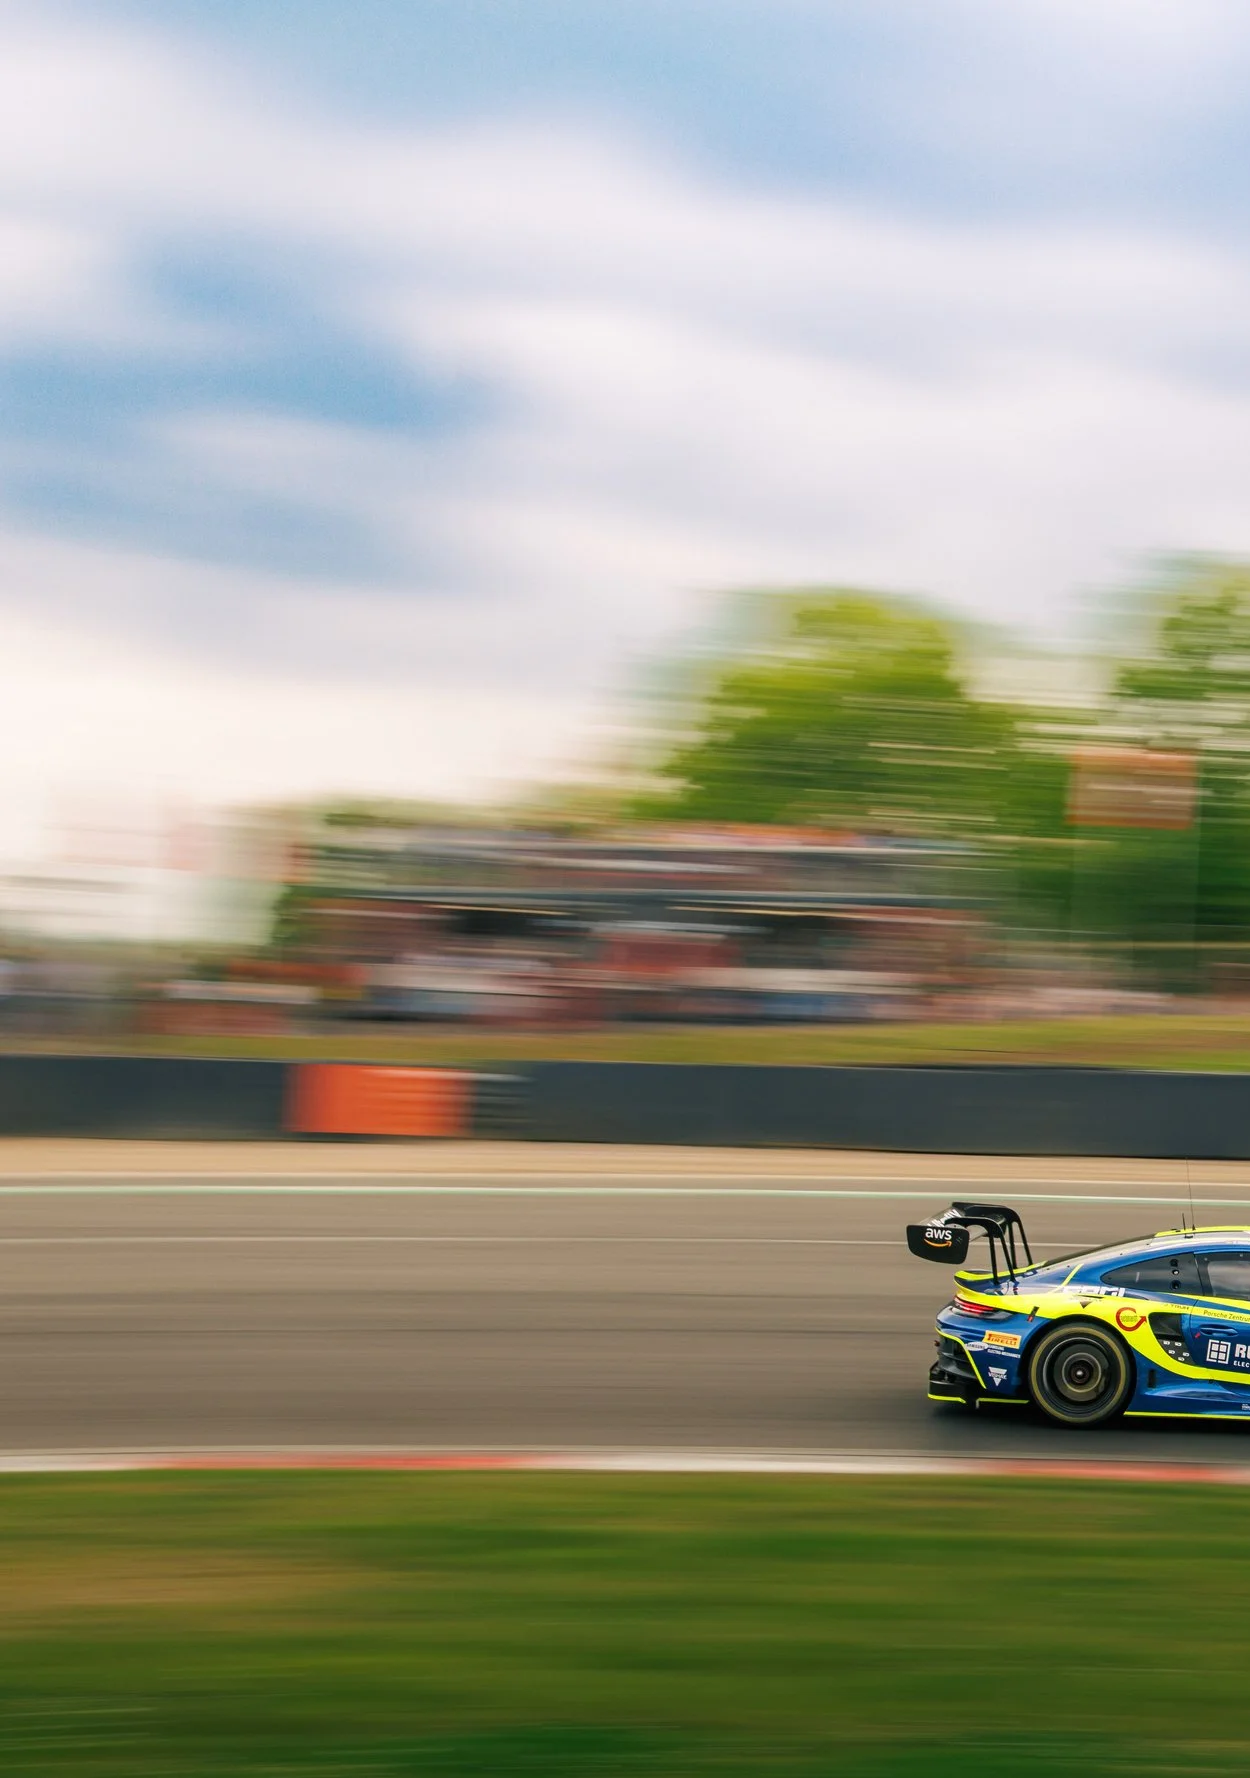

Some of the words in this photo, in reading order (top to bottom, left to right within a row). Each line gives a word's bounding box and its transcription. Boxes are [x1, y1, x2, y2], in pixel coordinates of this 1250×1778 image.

[925, 1228, 952, 1240] aws
[1203, 1309, 1227, 1318] Porsche
[987, 1333, 1018, 1346] PIRELLI
